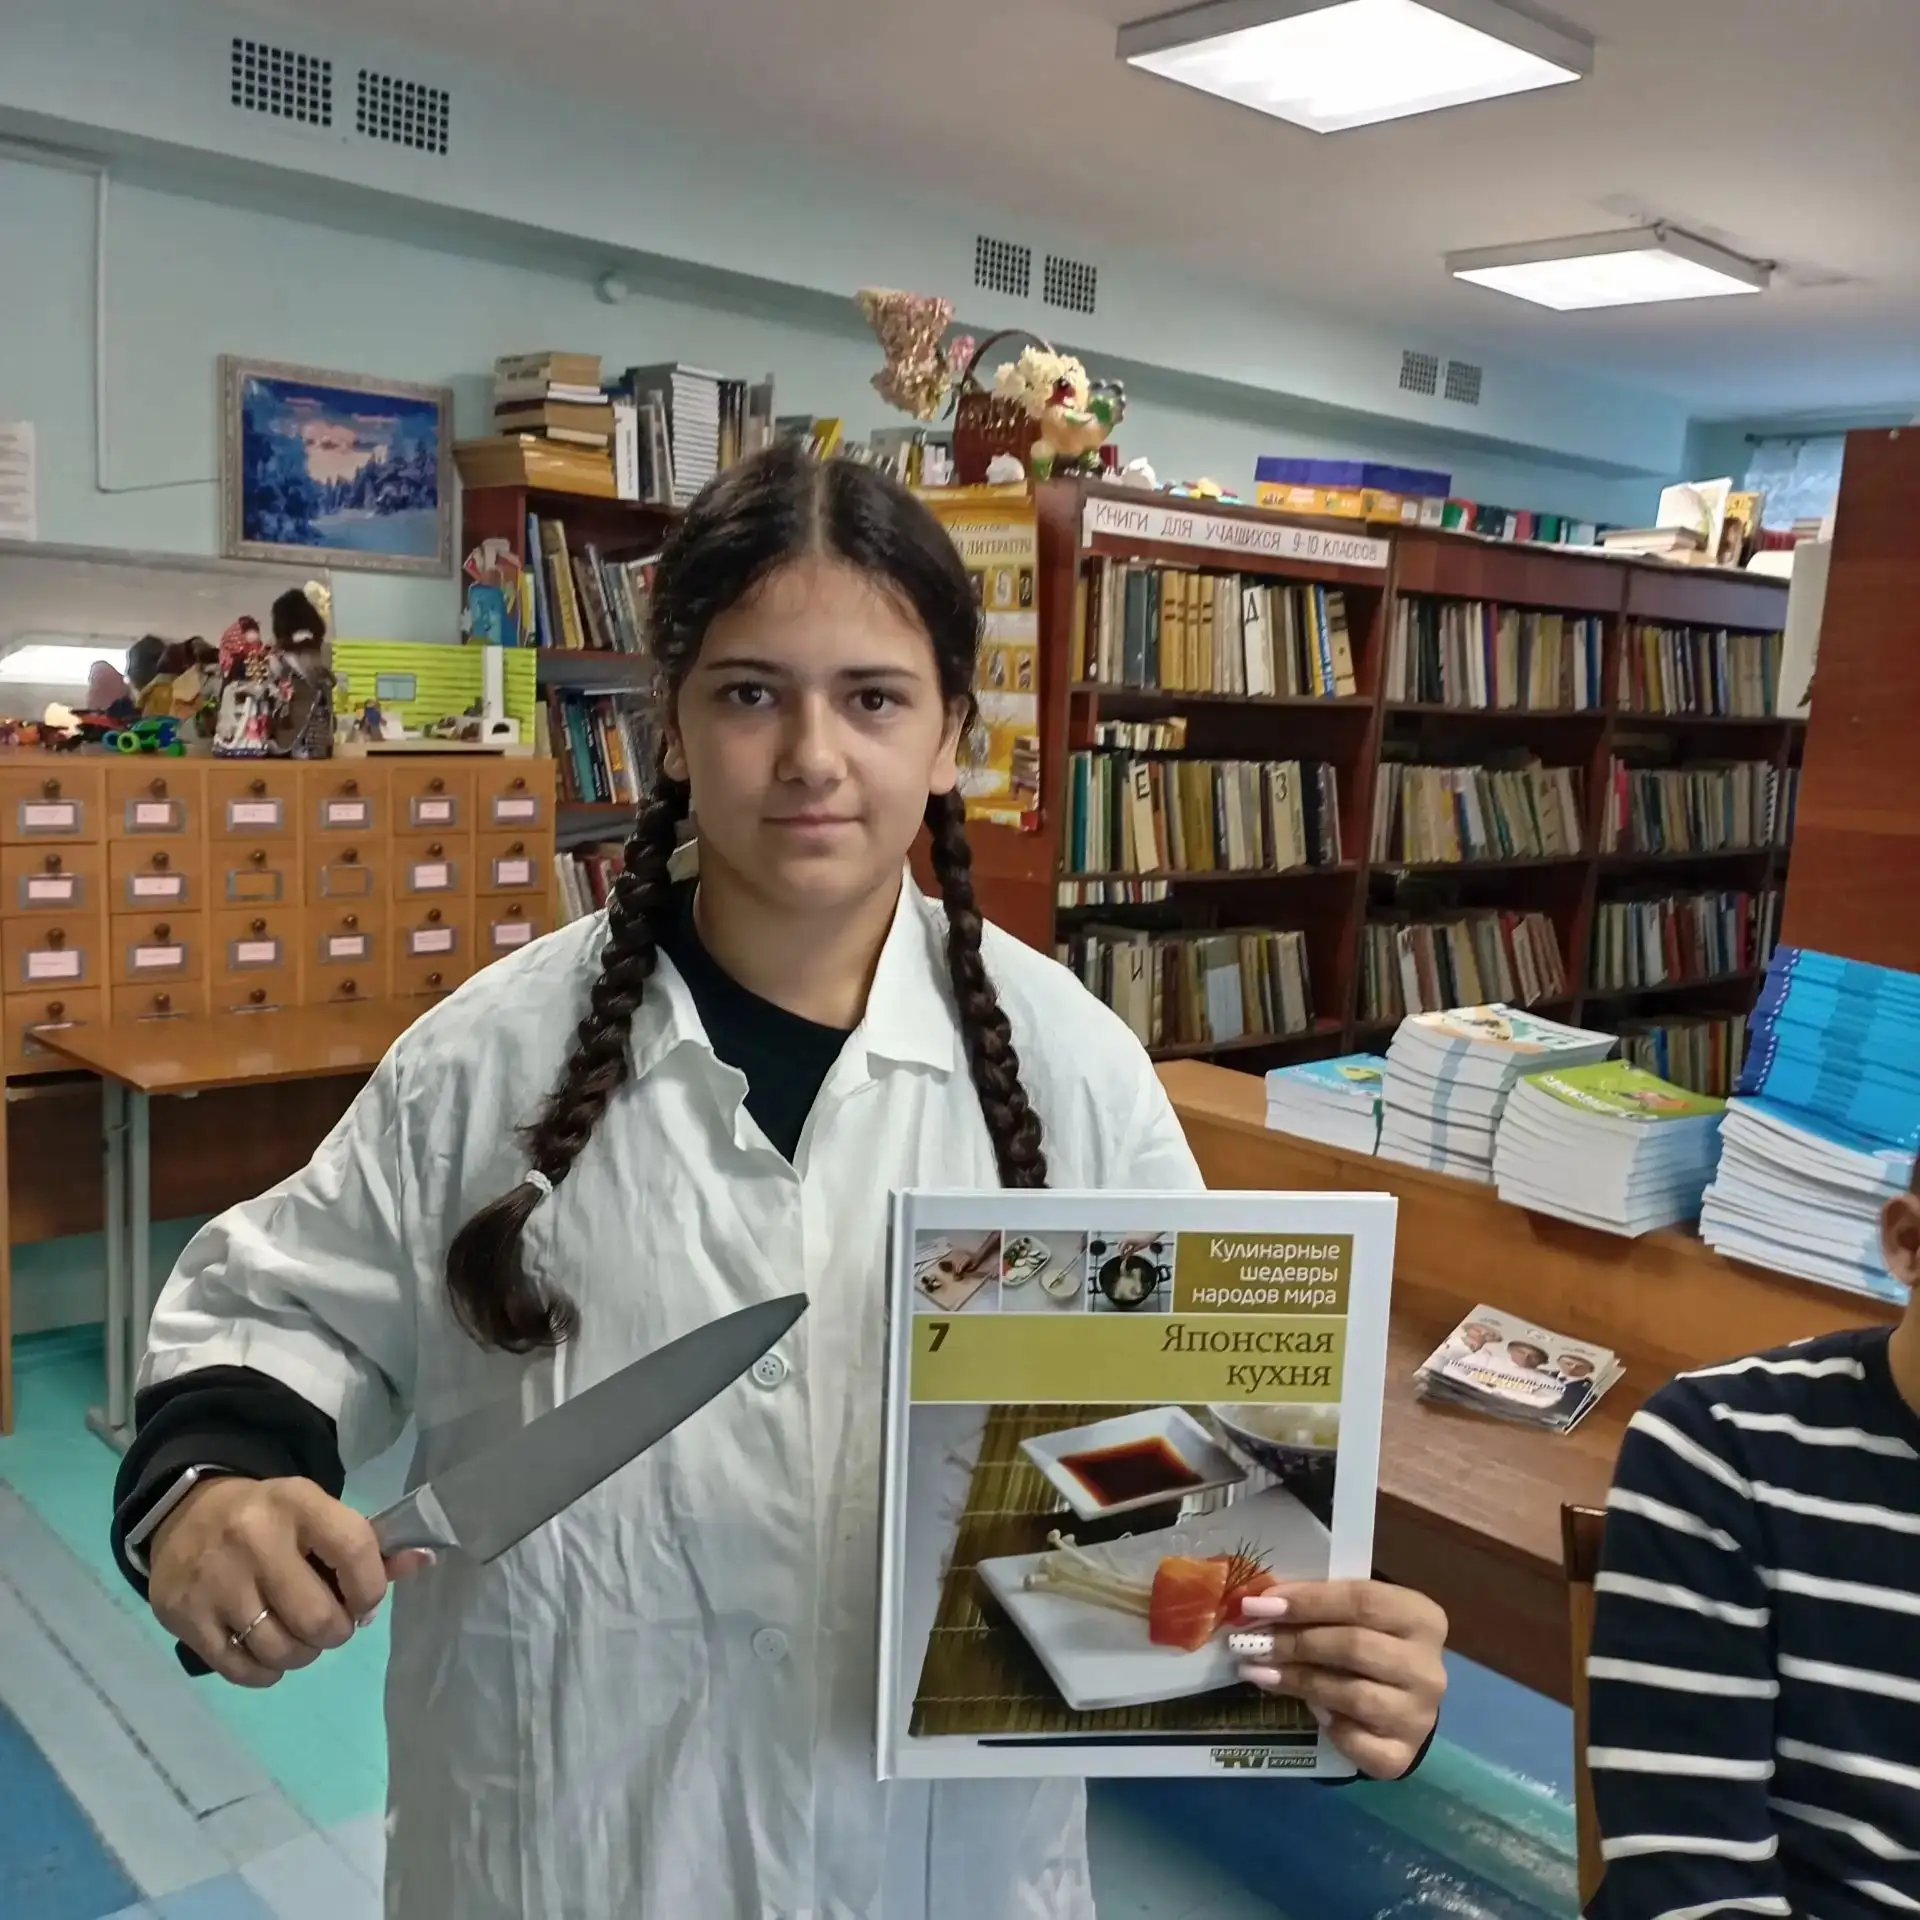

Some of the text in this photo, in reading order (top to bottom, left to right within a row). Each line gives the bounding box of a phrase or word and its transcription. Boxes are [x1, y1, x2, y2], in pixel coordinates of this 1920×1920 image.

[1096, 503, 1148, 532] КНИГИ
[1160, 516, 1192, 538] ДЛЯ
[1292, 532, 1319, 556] 9-10
[1323, 536, 1377, 561] КЛАССОВ
[1245, 591, 1259, 624] Д
[1135, 769, 1151, 800] Е
[1209, 1238, 1341, 1264] Кулинарные
[1239, 1264, 1339, 1287] шедевры
[1192, 1287, 1337, 1310] народов мира
[927, 1322, 951, 1353] 7
[1160, 1323, 1335, 1354] Японская
[1226, 1364, 1333, 1395] кухня
